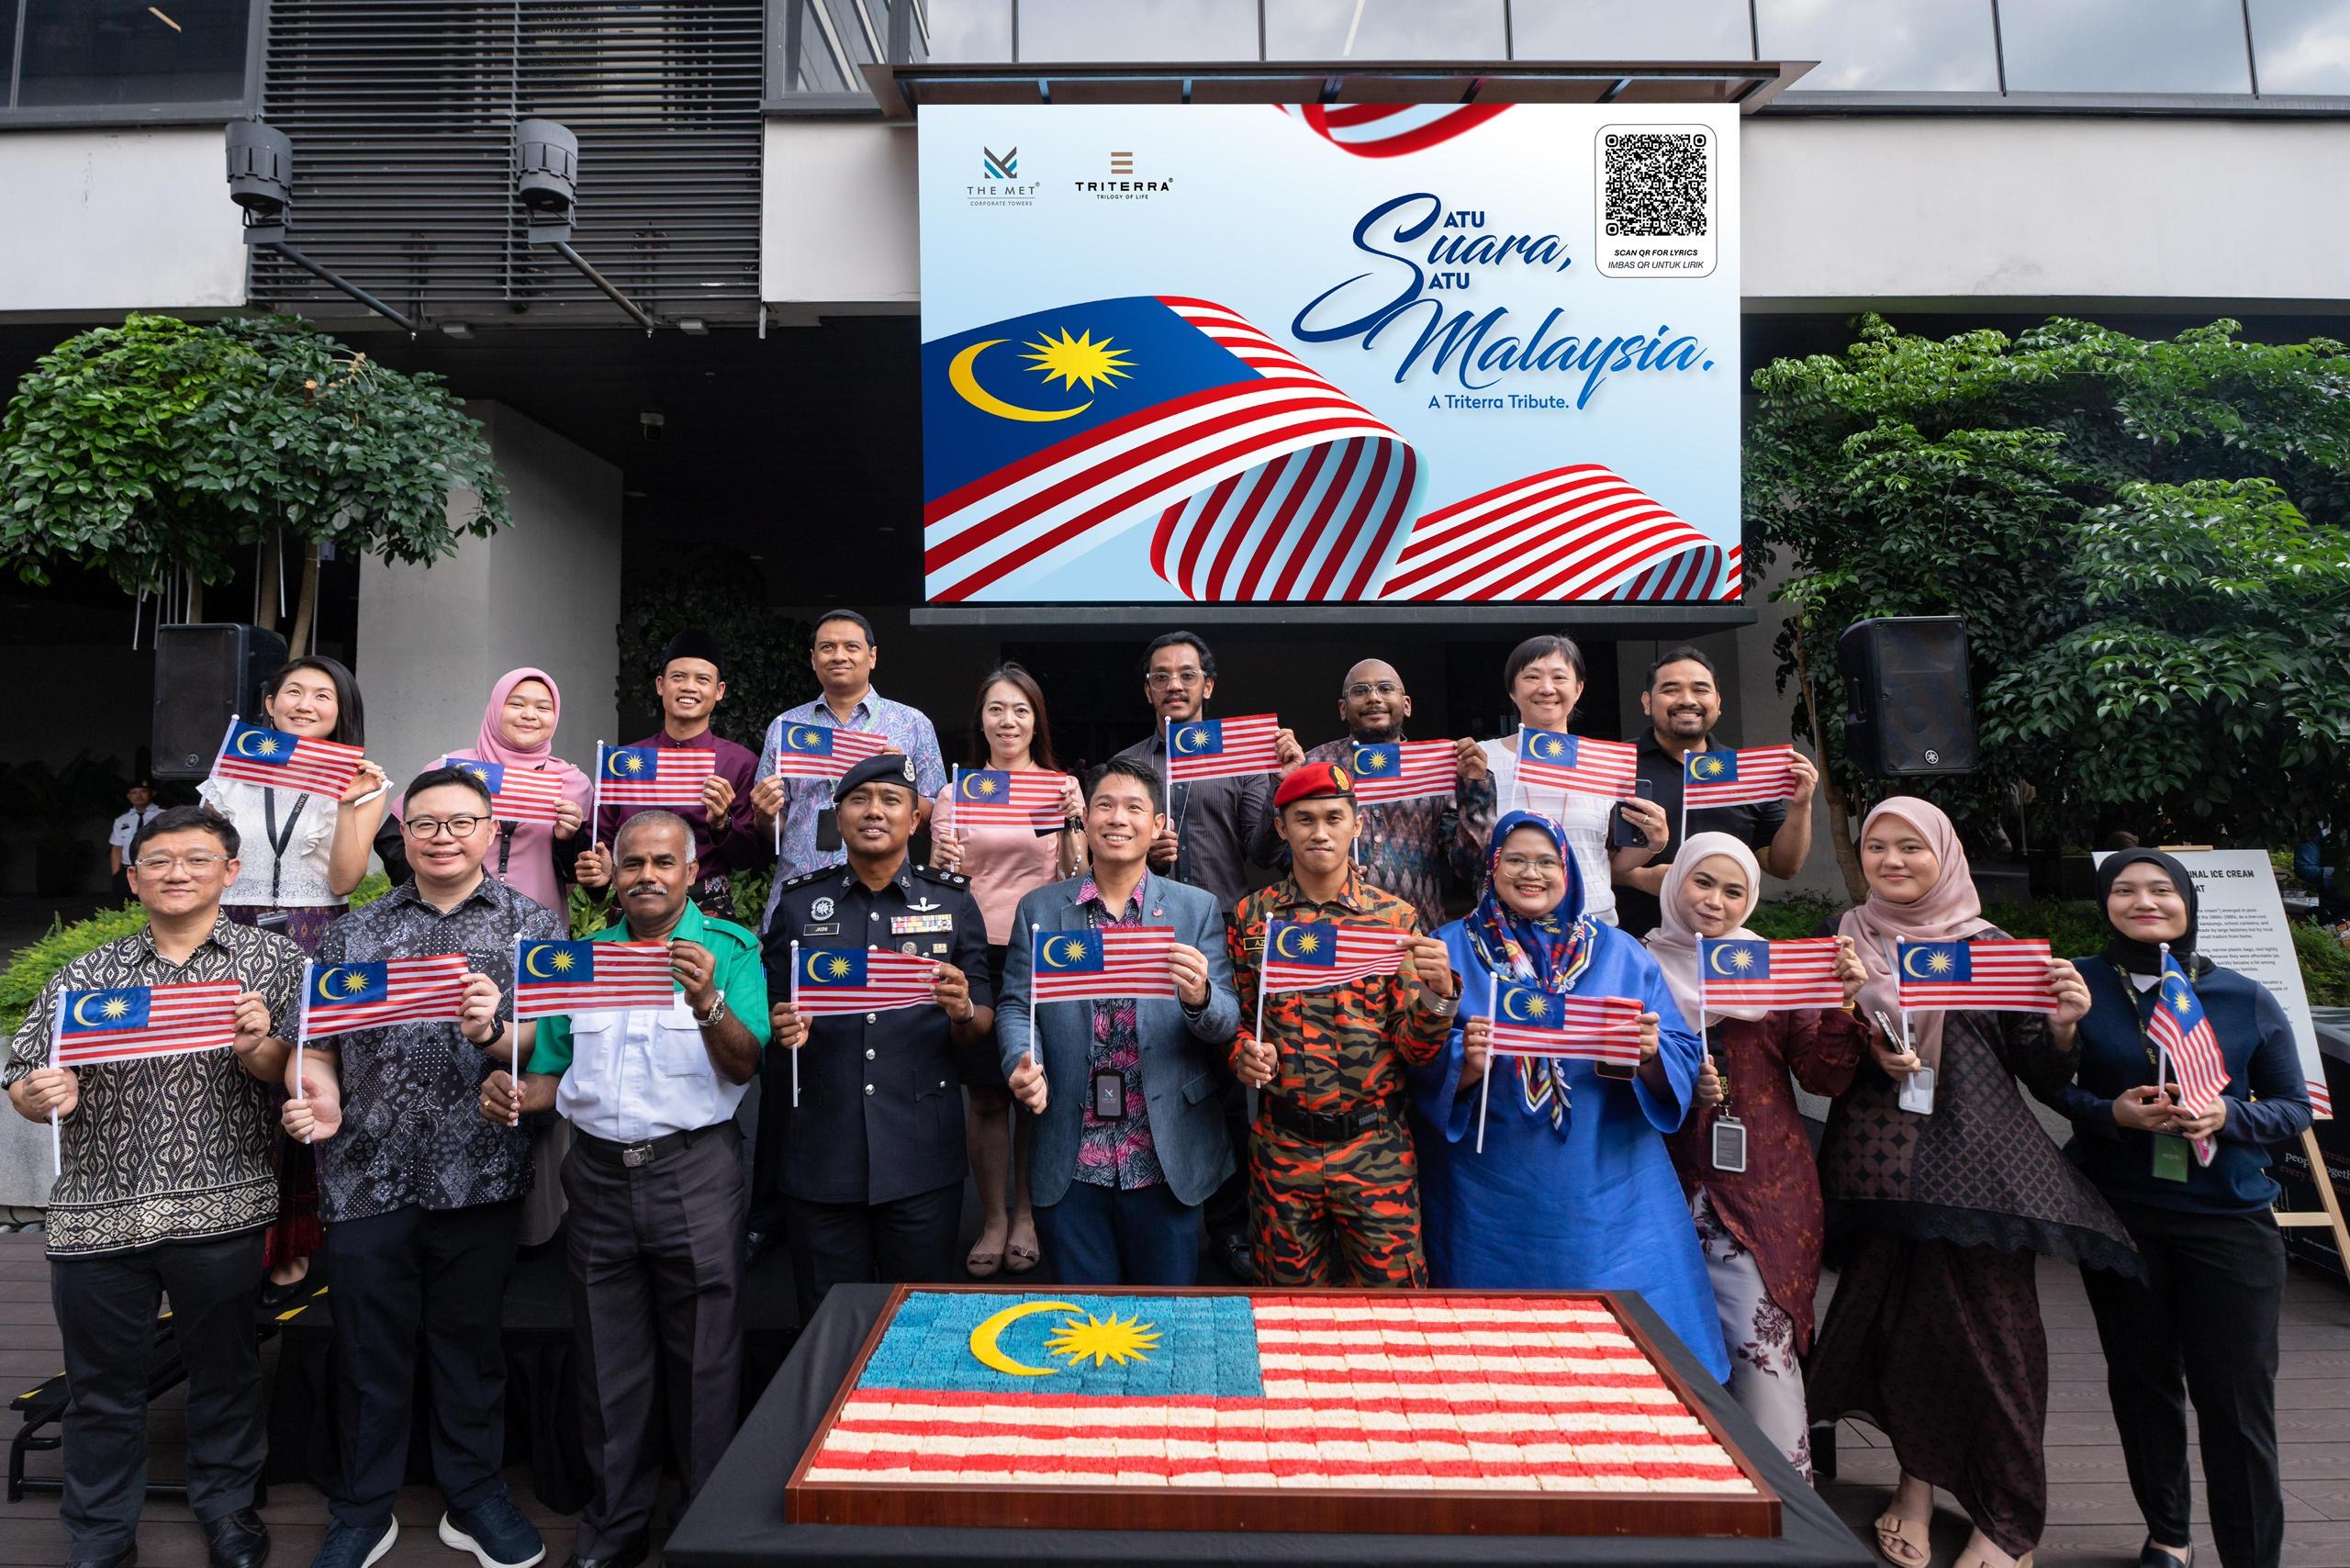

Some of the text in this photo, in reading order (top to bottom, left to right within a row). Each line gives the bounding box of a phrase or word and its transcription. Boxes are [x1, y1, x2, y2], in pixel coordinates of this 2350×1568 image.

[967, 186, 997, 196] THE
[1639, 249, 1651, 257] QR
[1608, 261, 1704, 269] IMBAS QR UNTUK LIRIK
[1362, 298, 1714, 410] Malaysia.
[1428, 394, 1569, 409] A Triterra Tribute.
[2189, 869, 2255, 879] INAL ICE CREAM
